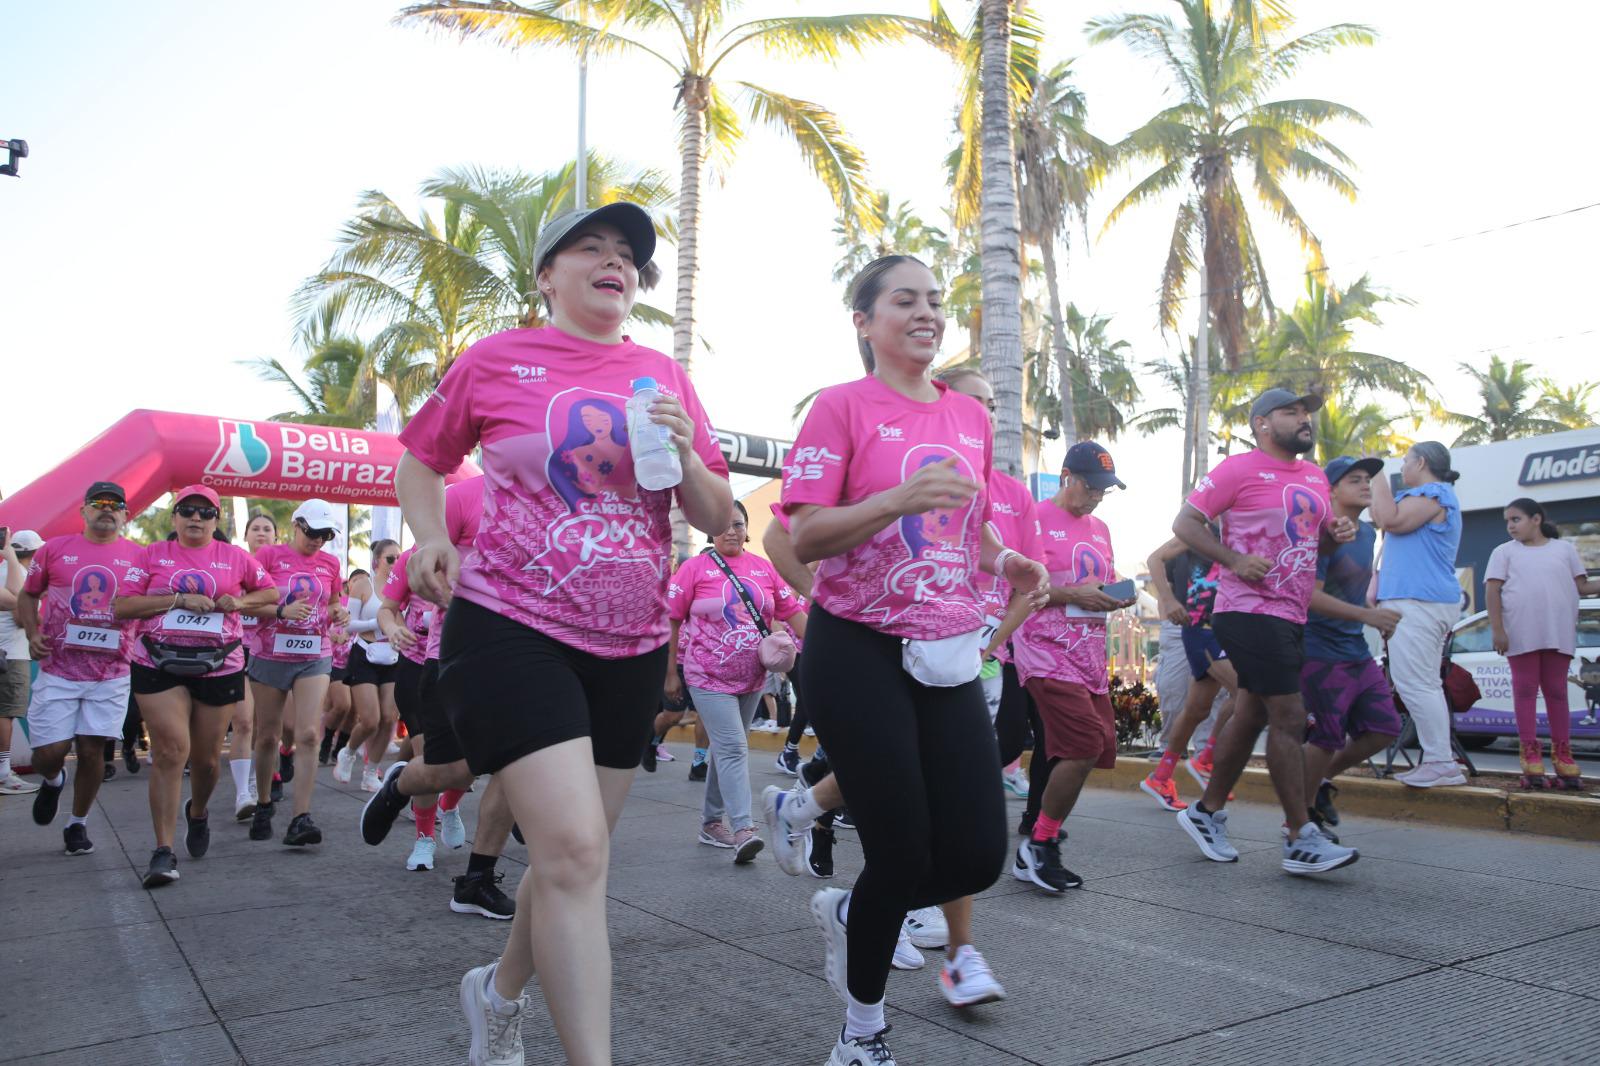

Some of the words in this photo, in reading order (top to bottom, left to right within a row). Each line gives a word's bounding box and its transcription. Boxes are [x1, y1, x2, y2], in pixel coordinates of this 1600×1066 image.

[517, 366, 547, 378] DIF
[880, 427, 902, 437] DIF
[280, 427, 369, 455] Delia
[281, 450, 393, 485] Barraz
[1526, 449, 1600, 482] Mode
[202, 475, 276, 490] Confianza
[279, 482, 306, 493] para
[315, 483, 328, 494] tu
[331, 485, 397, 498] diagnóstic
[553, 514, 646, 562] Rosa
[571, 577, 621, 589] Centro
[891, 560, 966, 601] Rosa
[176, 614, 210, 626] 0747
[78, 630, 107, 642] 0174
[286, 639, 312, 649] 0750
